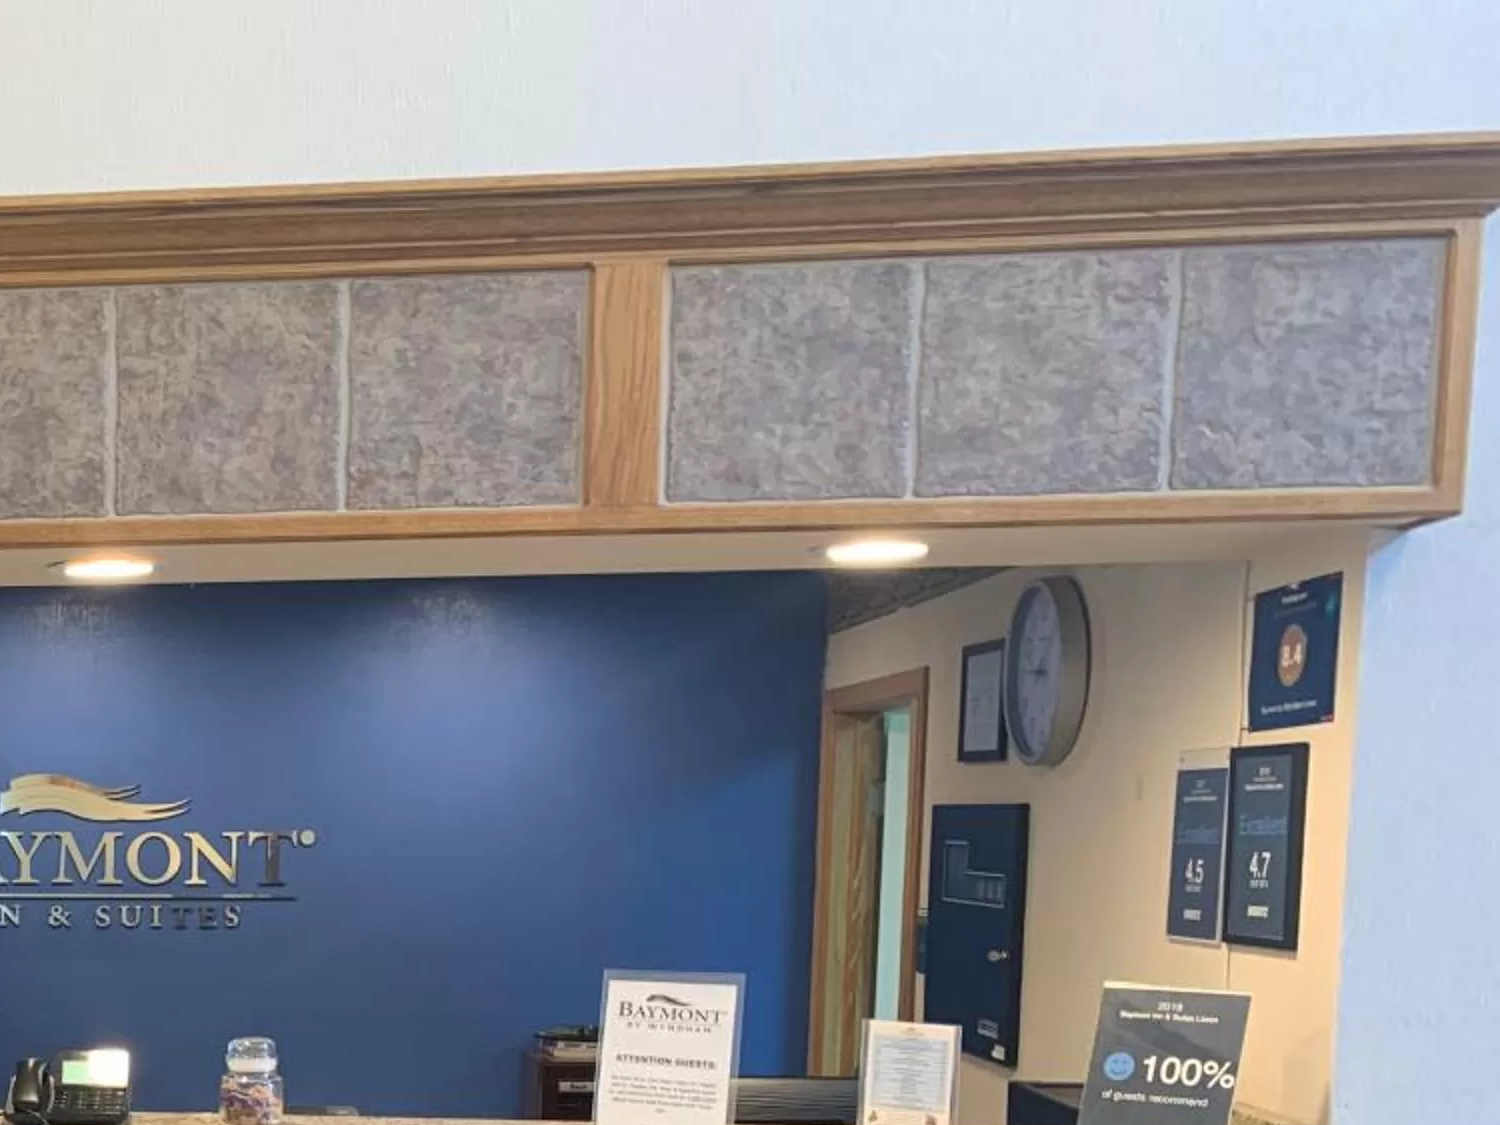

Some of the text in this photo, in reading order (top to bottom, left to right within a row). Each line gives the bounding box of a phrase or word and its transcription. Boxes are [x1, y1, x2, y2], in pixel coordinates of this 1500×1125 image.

[1185, 857, 1204, 883] 4.5
[1249, 851, 1272, 878] 4.7
[47, 904, 74, 929] &
[94, 904, 243, 930] SUITES
[618, 1001, 721, 1025] BAYMONT
[616, 1053, 672, 1066] ATTENTION
[1142, 1055, 1236, 1089] 100%
[1101, 1089, 1113, 1100] of
[1113, 1091, 1146, 1103] guests
